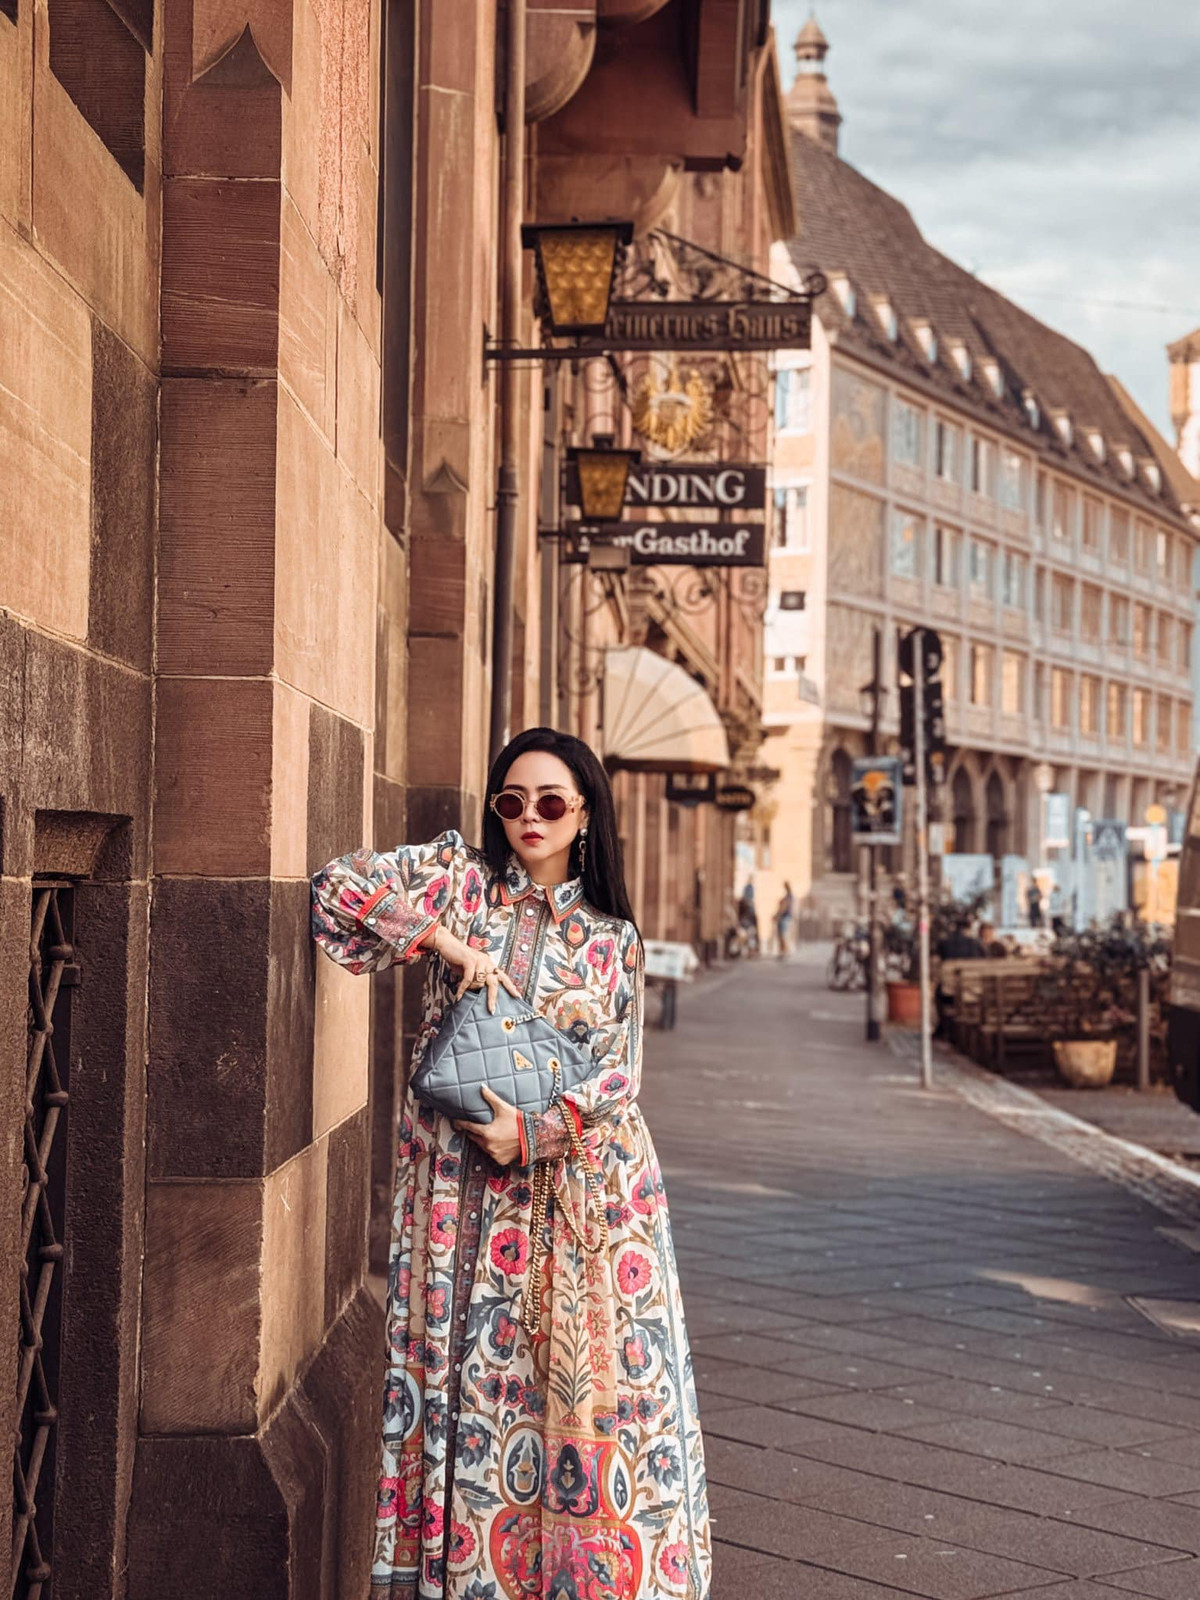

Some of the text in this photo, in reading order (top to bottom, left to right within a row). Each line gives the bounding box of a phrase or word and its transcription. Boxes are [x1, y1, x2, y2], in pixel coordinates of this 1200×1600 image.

[605, 303, 799, 340] einernes Haus
[625, 469, 746, 505] NDING
[633, 527, 751, 557] Gasthof
